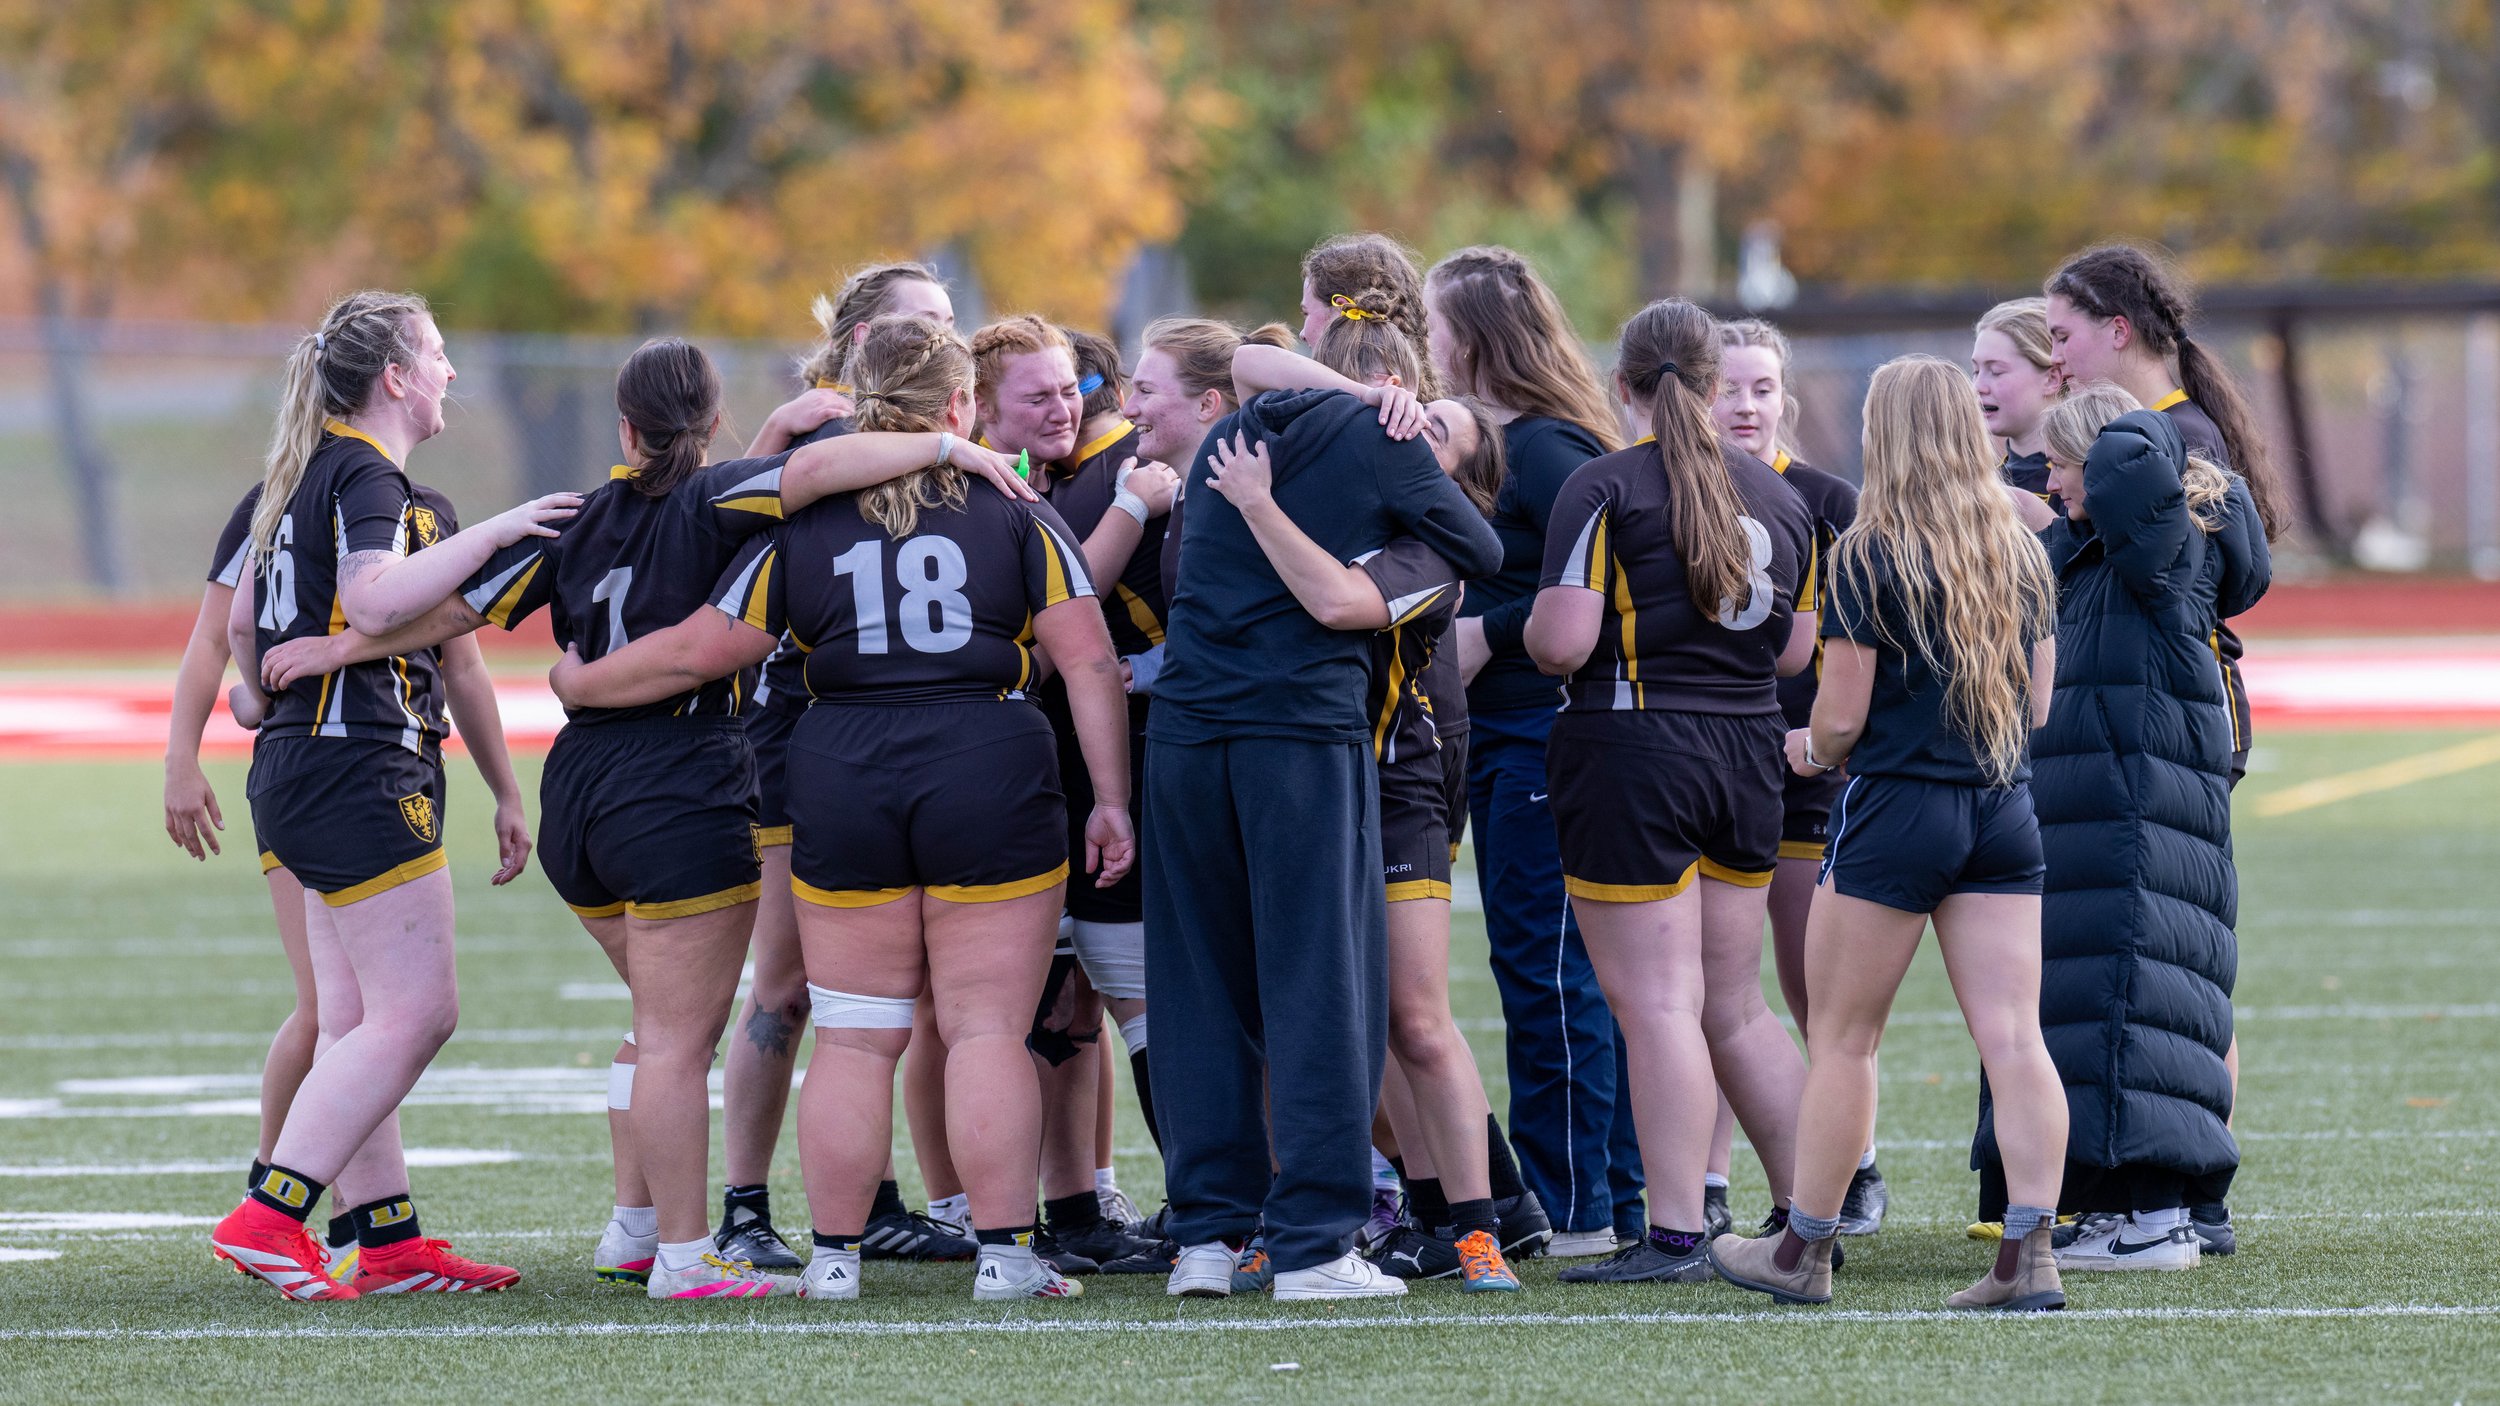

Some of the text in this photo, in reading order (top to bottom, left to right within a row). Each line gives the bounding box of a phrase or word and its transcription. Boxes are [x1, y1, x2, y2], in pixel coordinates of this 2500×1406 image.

[592, 566, 633, 656] 1
[832, 534, 974, 654] 18
[260, 1169, 310, 1208] D
[1674, 1260, 1701, 1273] TIEMPO
